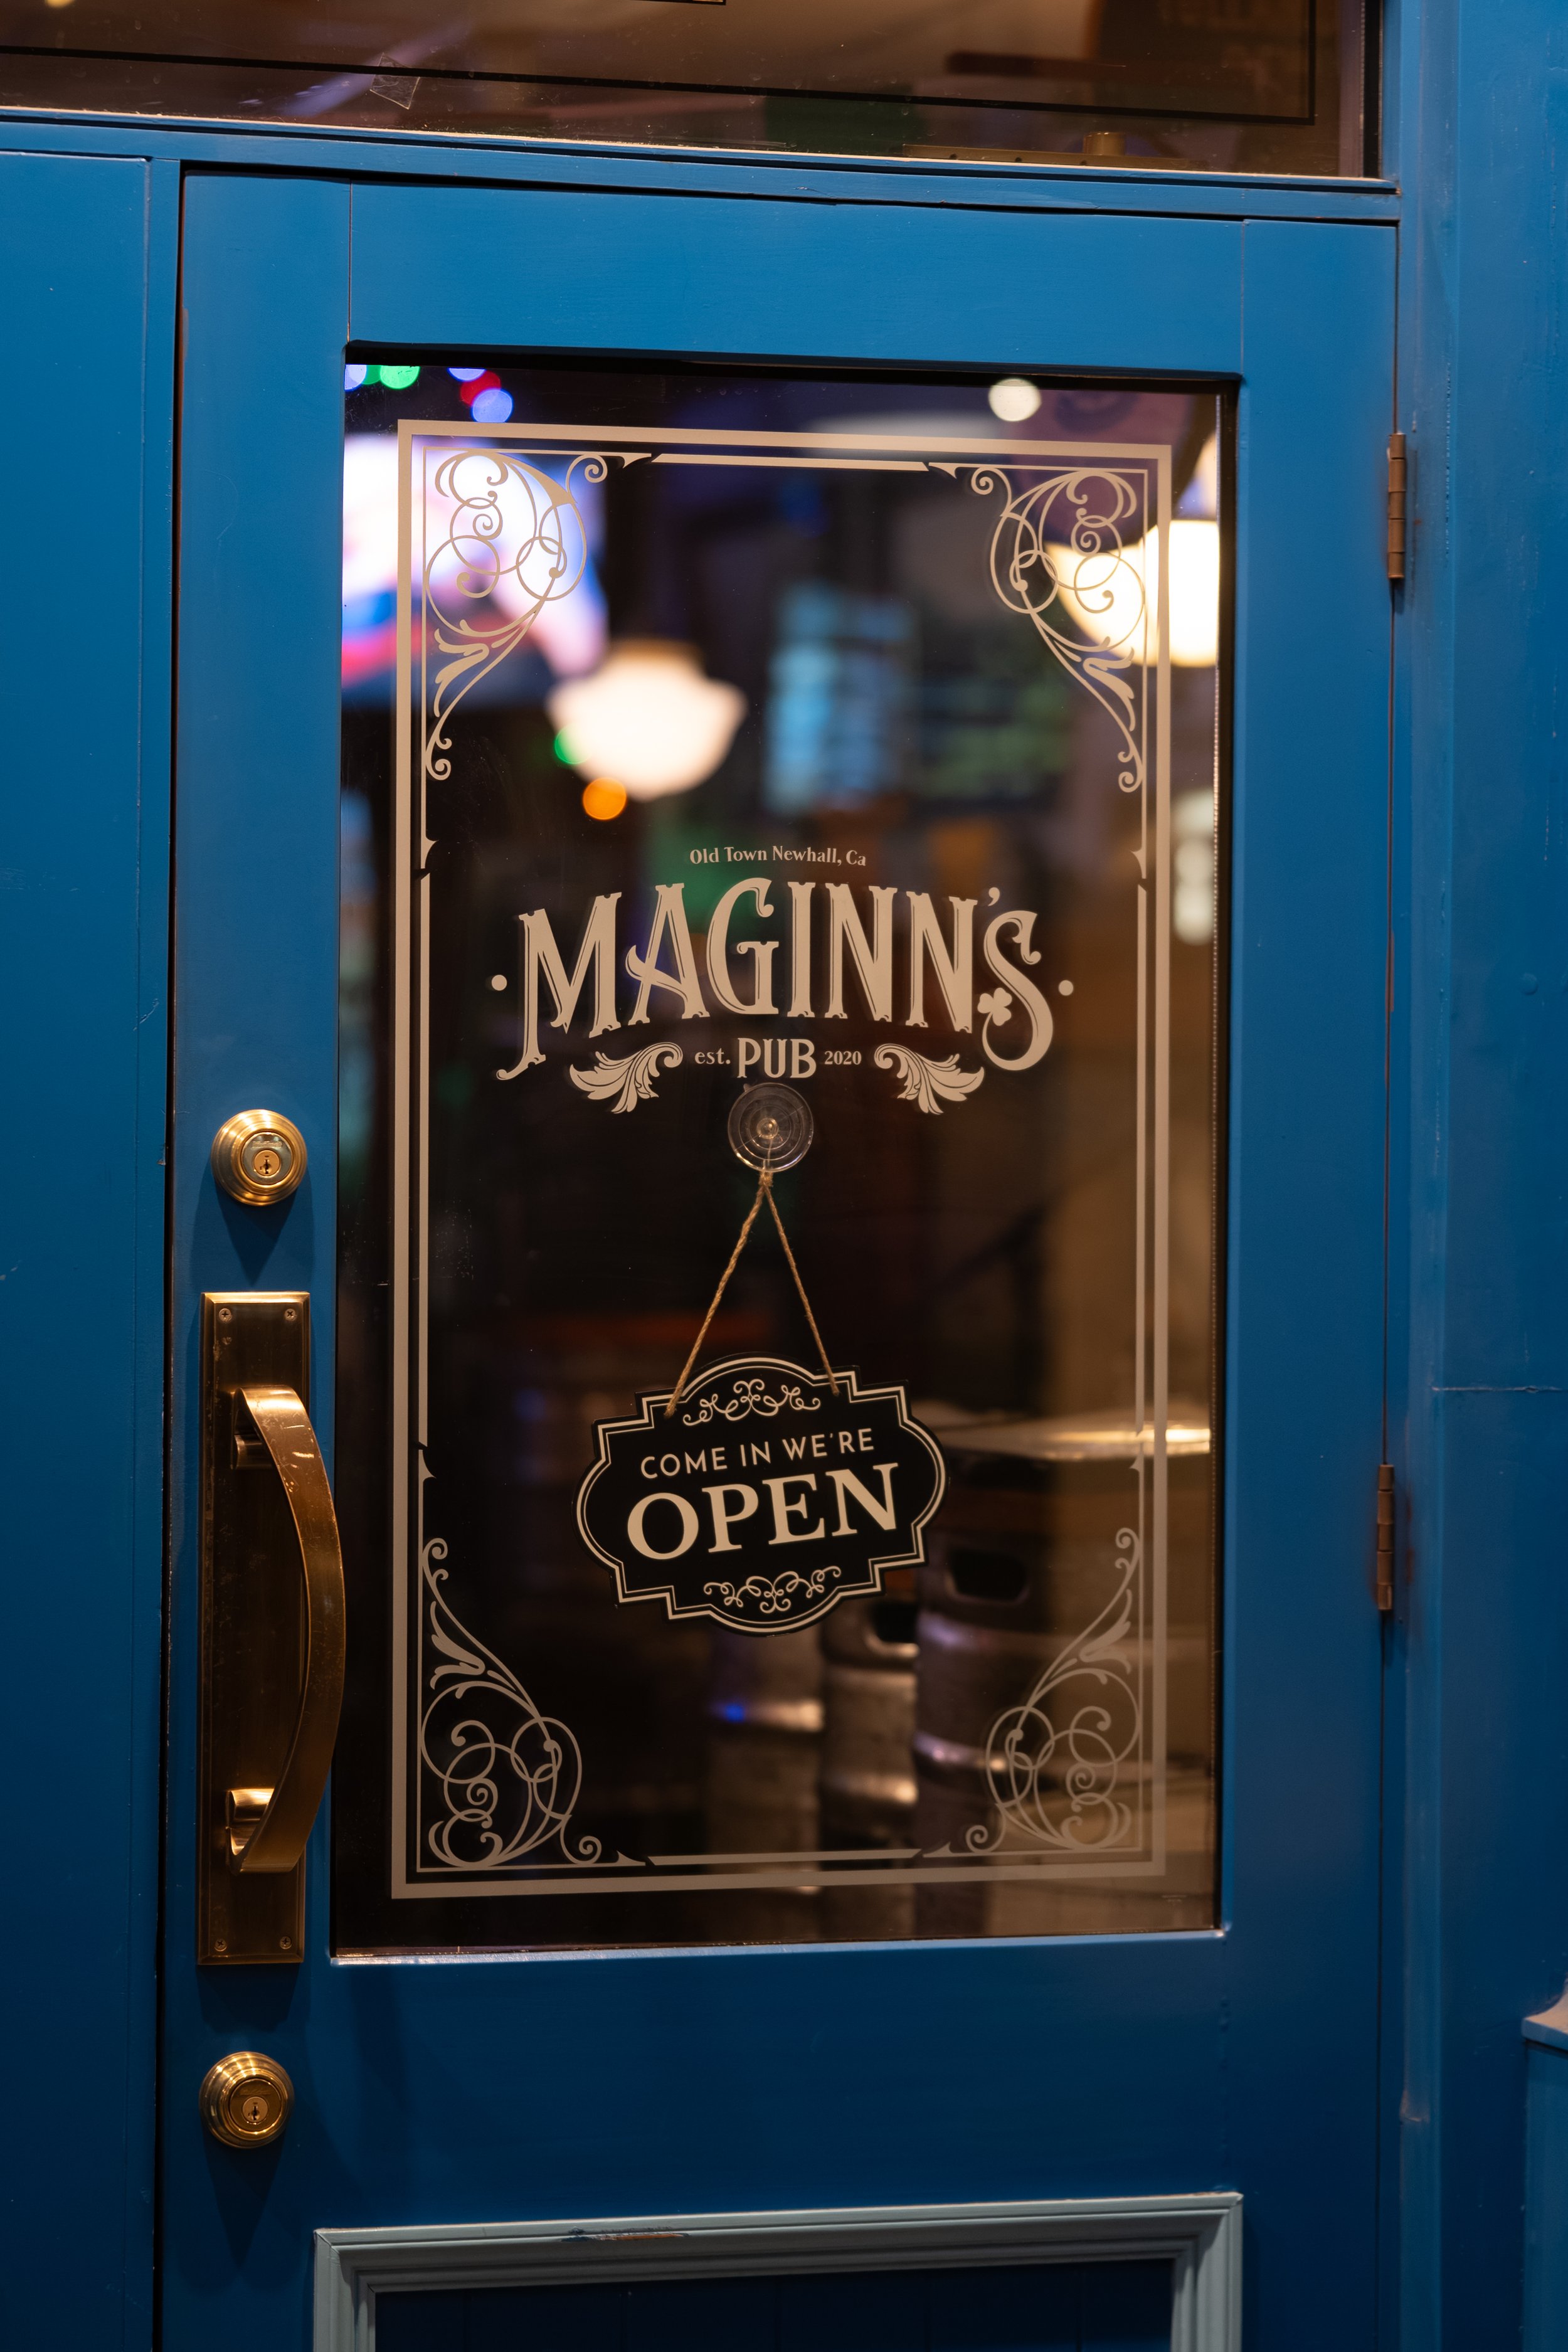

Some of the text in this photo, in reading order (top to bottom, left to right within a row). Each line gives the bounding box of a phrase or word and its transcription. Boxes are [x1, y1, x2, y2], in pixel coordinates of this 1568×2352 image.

[689, 845, 866, 866] Old Town Newhall, Ca
[495, 877, 1054, 1080] MAGINN'S
[694, 1037, 862, 1078] est. PUB 2020
[640, 1428, 874, 1479] COME IN WE'RE
[627, 1462, 898, 1560] OPEN
